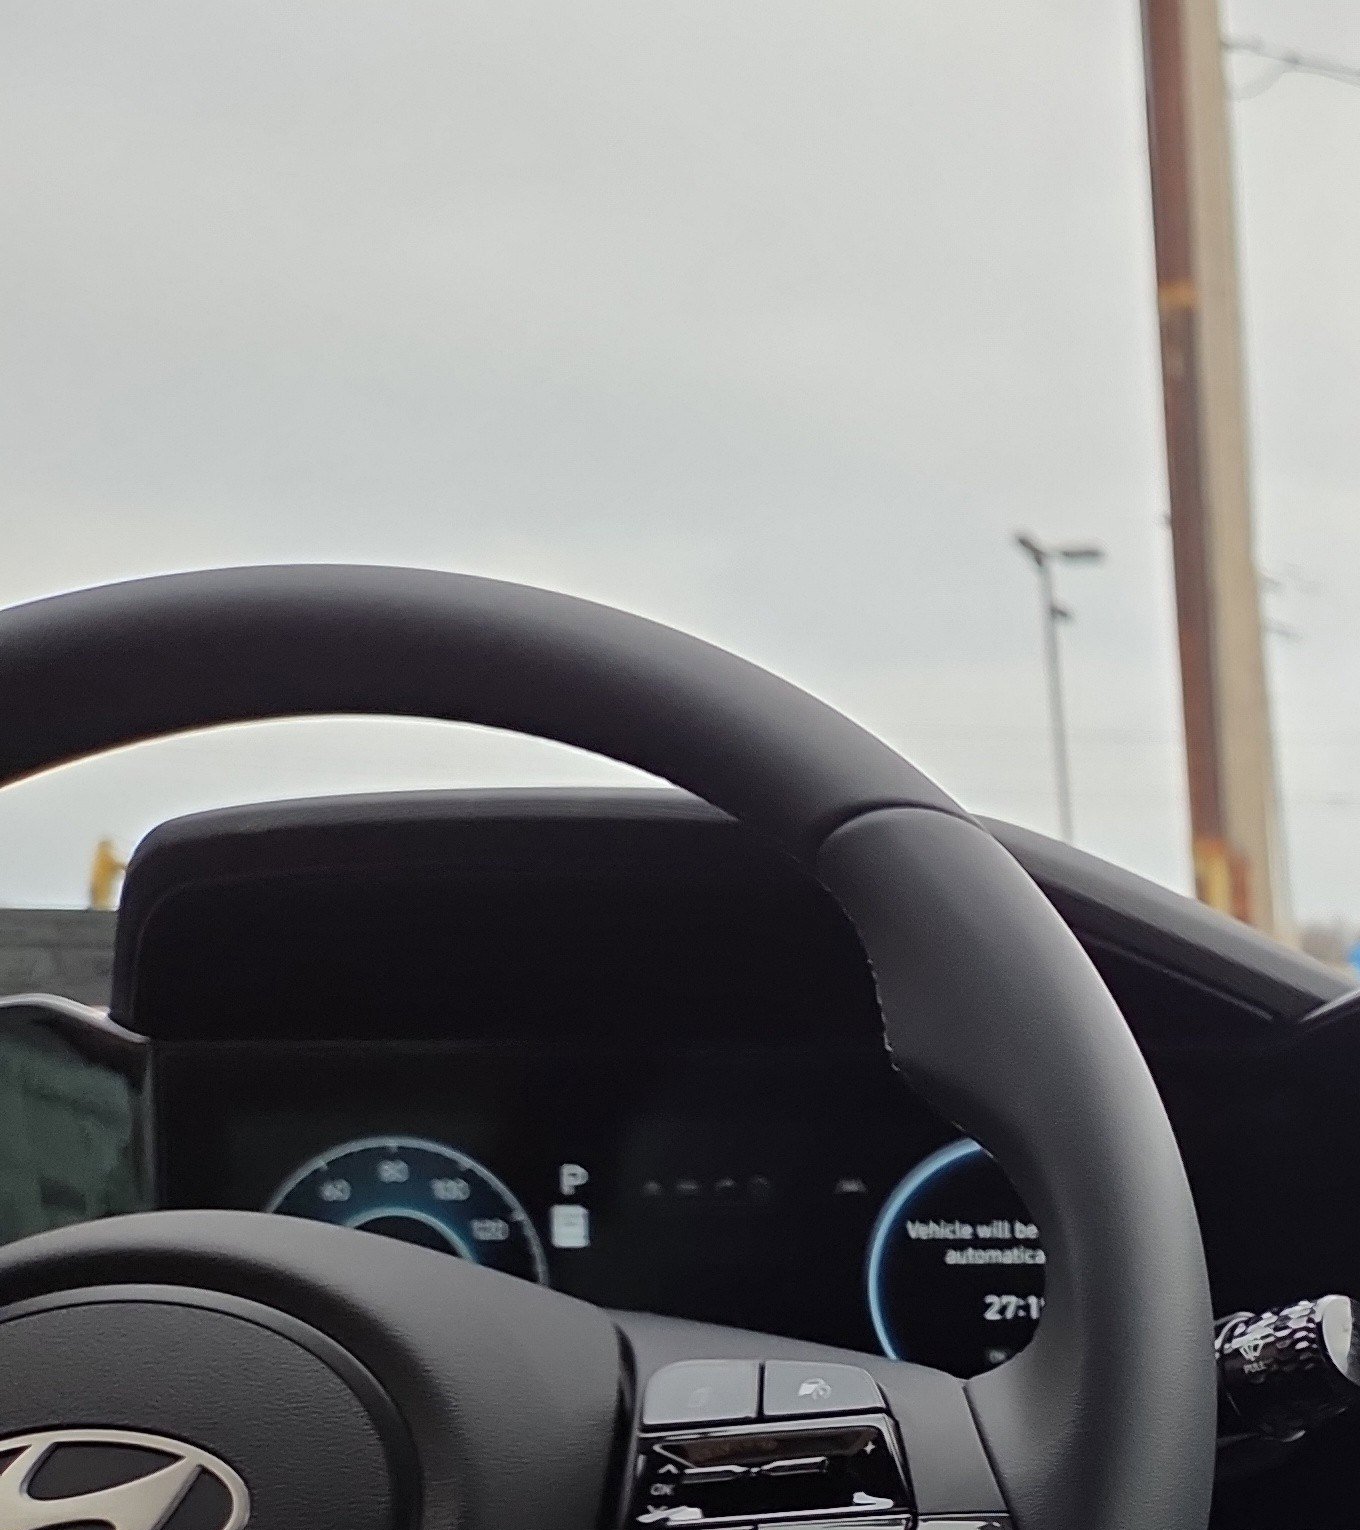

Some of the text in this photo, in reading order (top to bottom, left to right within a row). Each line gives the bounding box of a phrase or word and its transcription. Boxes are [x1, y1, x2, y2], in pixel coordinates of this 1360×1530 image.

[560, 1164, 588, 1195] P
[906, 1219, 1039, 1239] Vehicle will be
[983, 1294, 1045, 1320] 27:1
